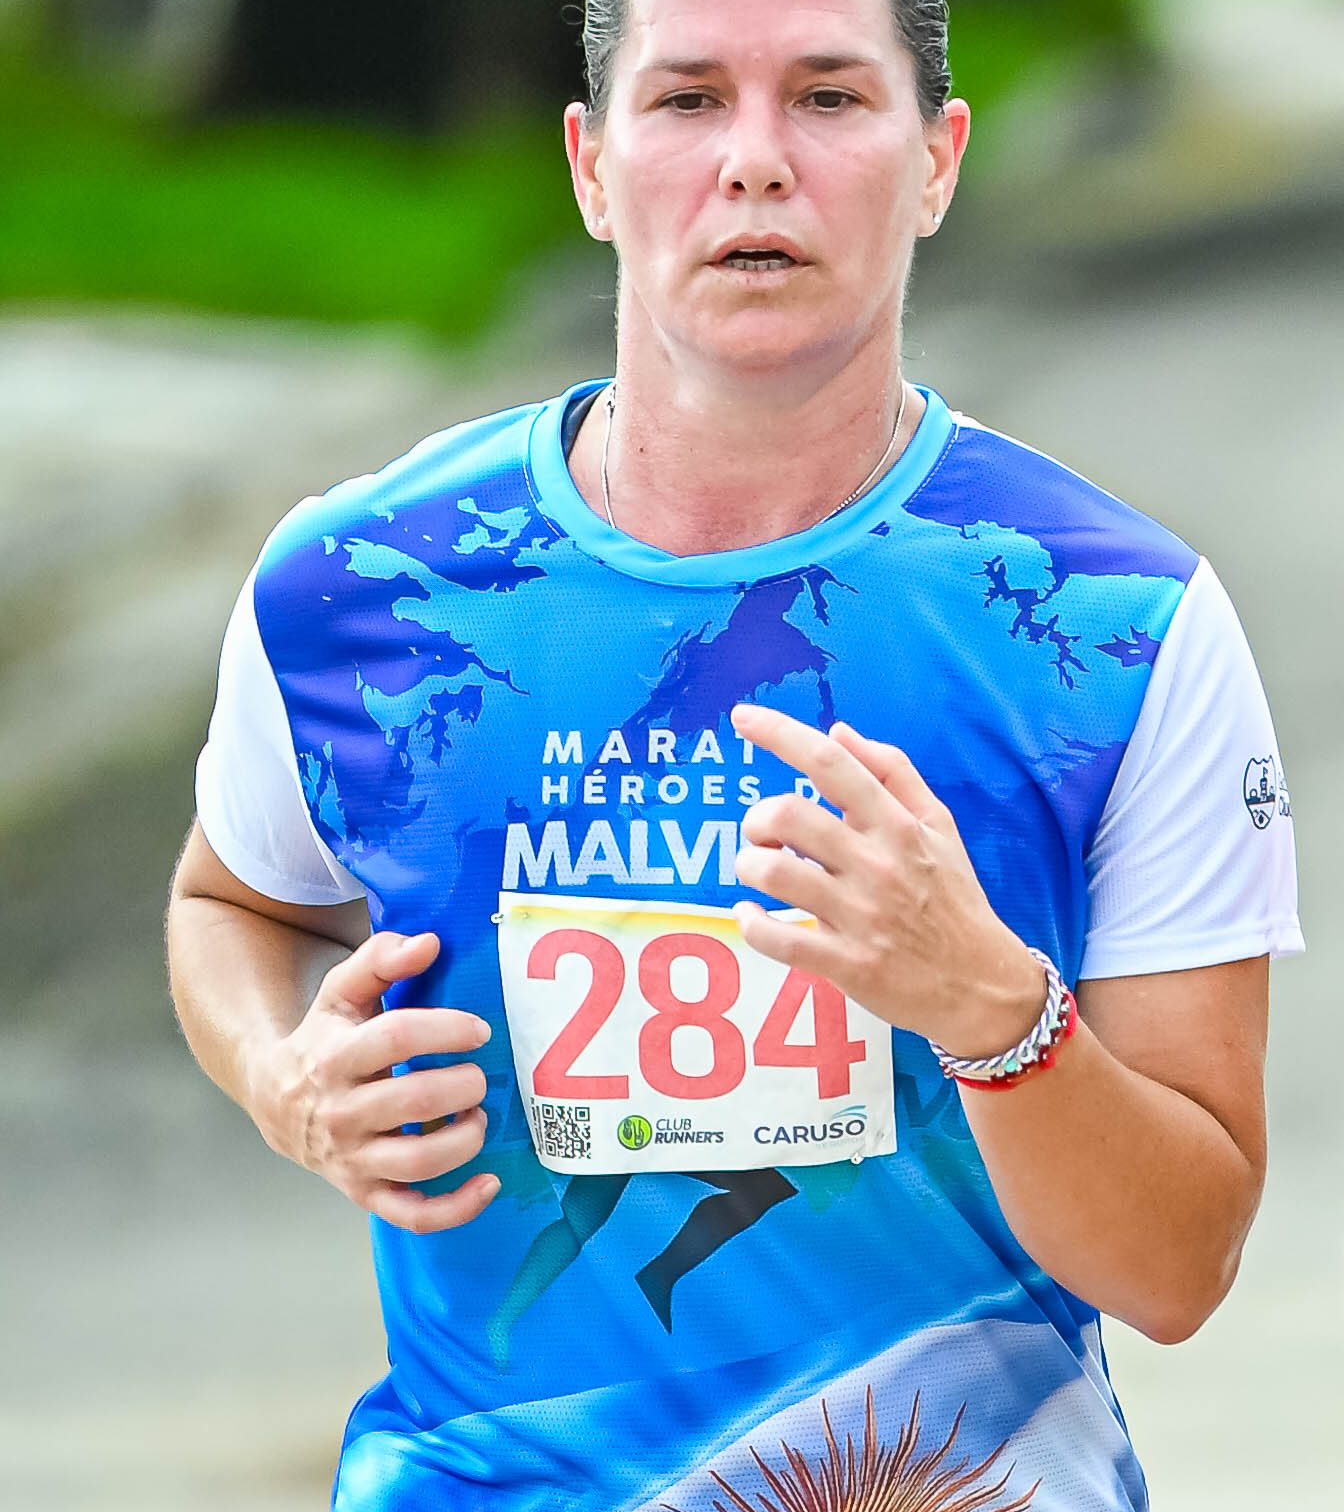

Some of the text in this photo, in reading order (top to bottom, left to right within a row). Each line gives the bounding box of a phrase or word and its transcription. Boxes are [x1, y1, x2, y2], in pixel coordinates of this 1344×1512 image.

[541, 729, 755, 765] MARAT
[541, 768, 821, 806] HÉROES D
[501, 819, 824, 890] MALVI
[526, 928, 867, 1101] 284
[654, 1131, 725, 1144] RUNNER'S
[655, 1118, 692, 1131] CLUB
[753, 1119, 865, 1144] CARUSO
